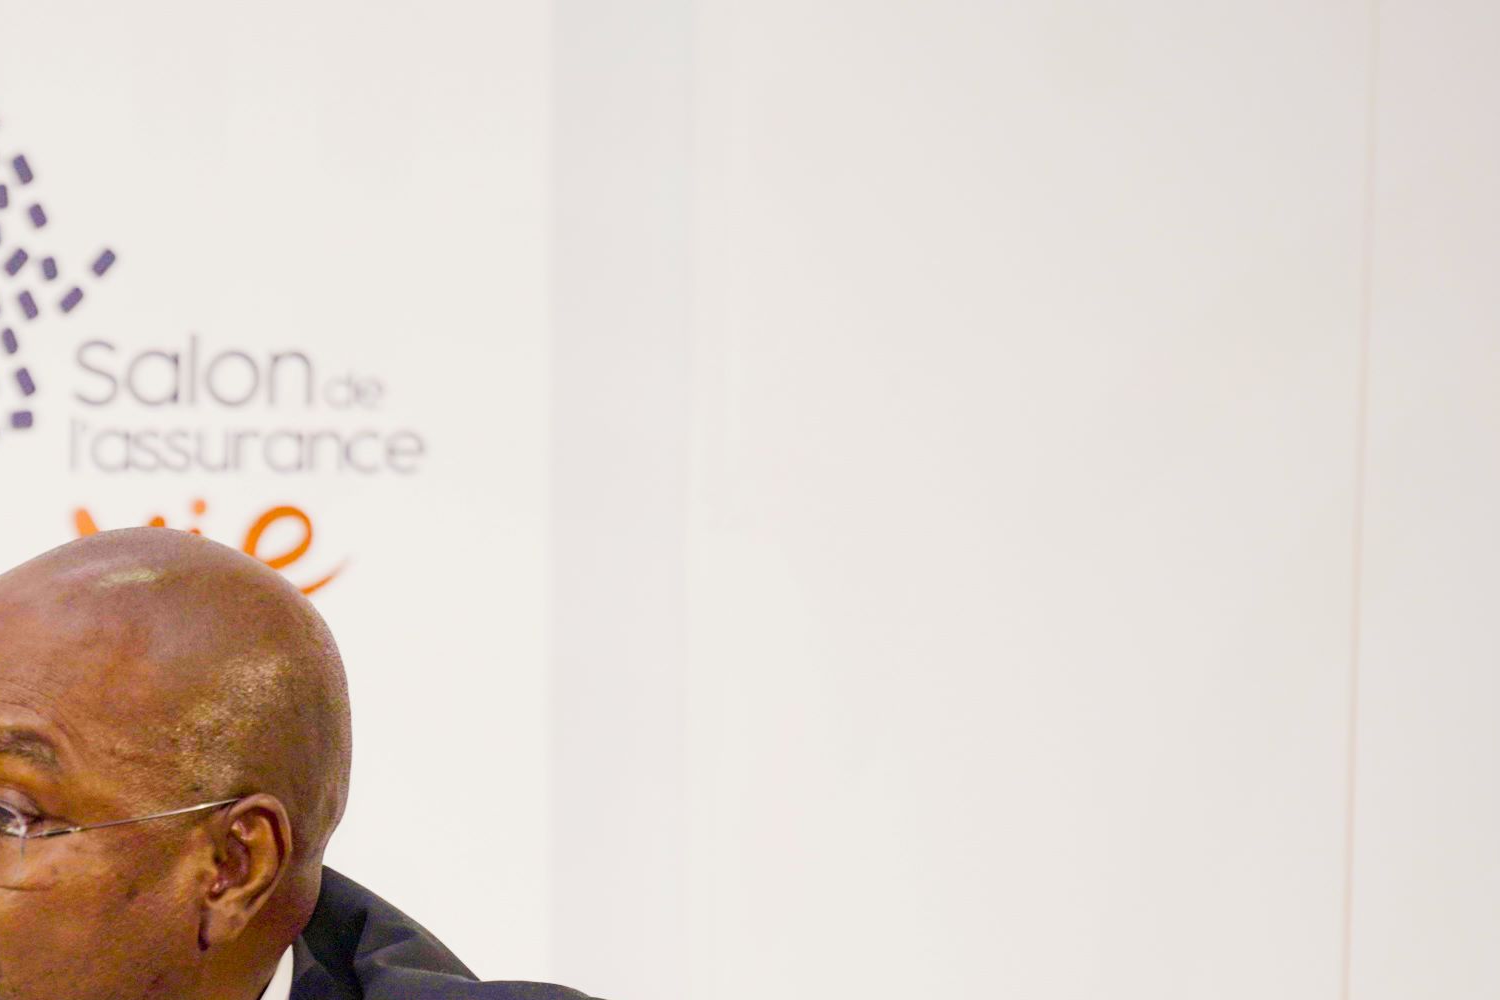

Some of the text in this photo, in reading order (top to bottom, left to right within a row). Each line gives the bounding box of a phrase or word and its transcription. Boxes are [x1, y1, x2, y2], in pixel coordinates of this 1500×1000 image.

[74, 334, 387, 409] Salon de
[69, 417, 427, 474] l'assurance
